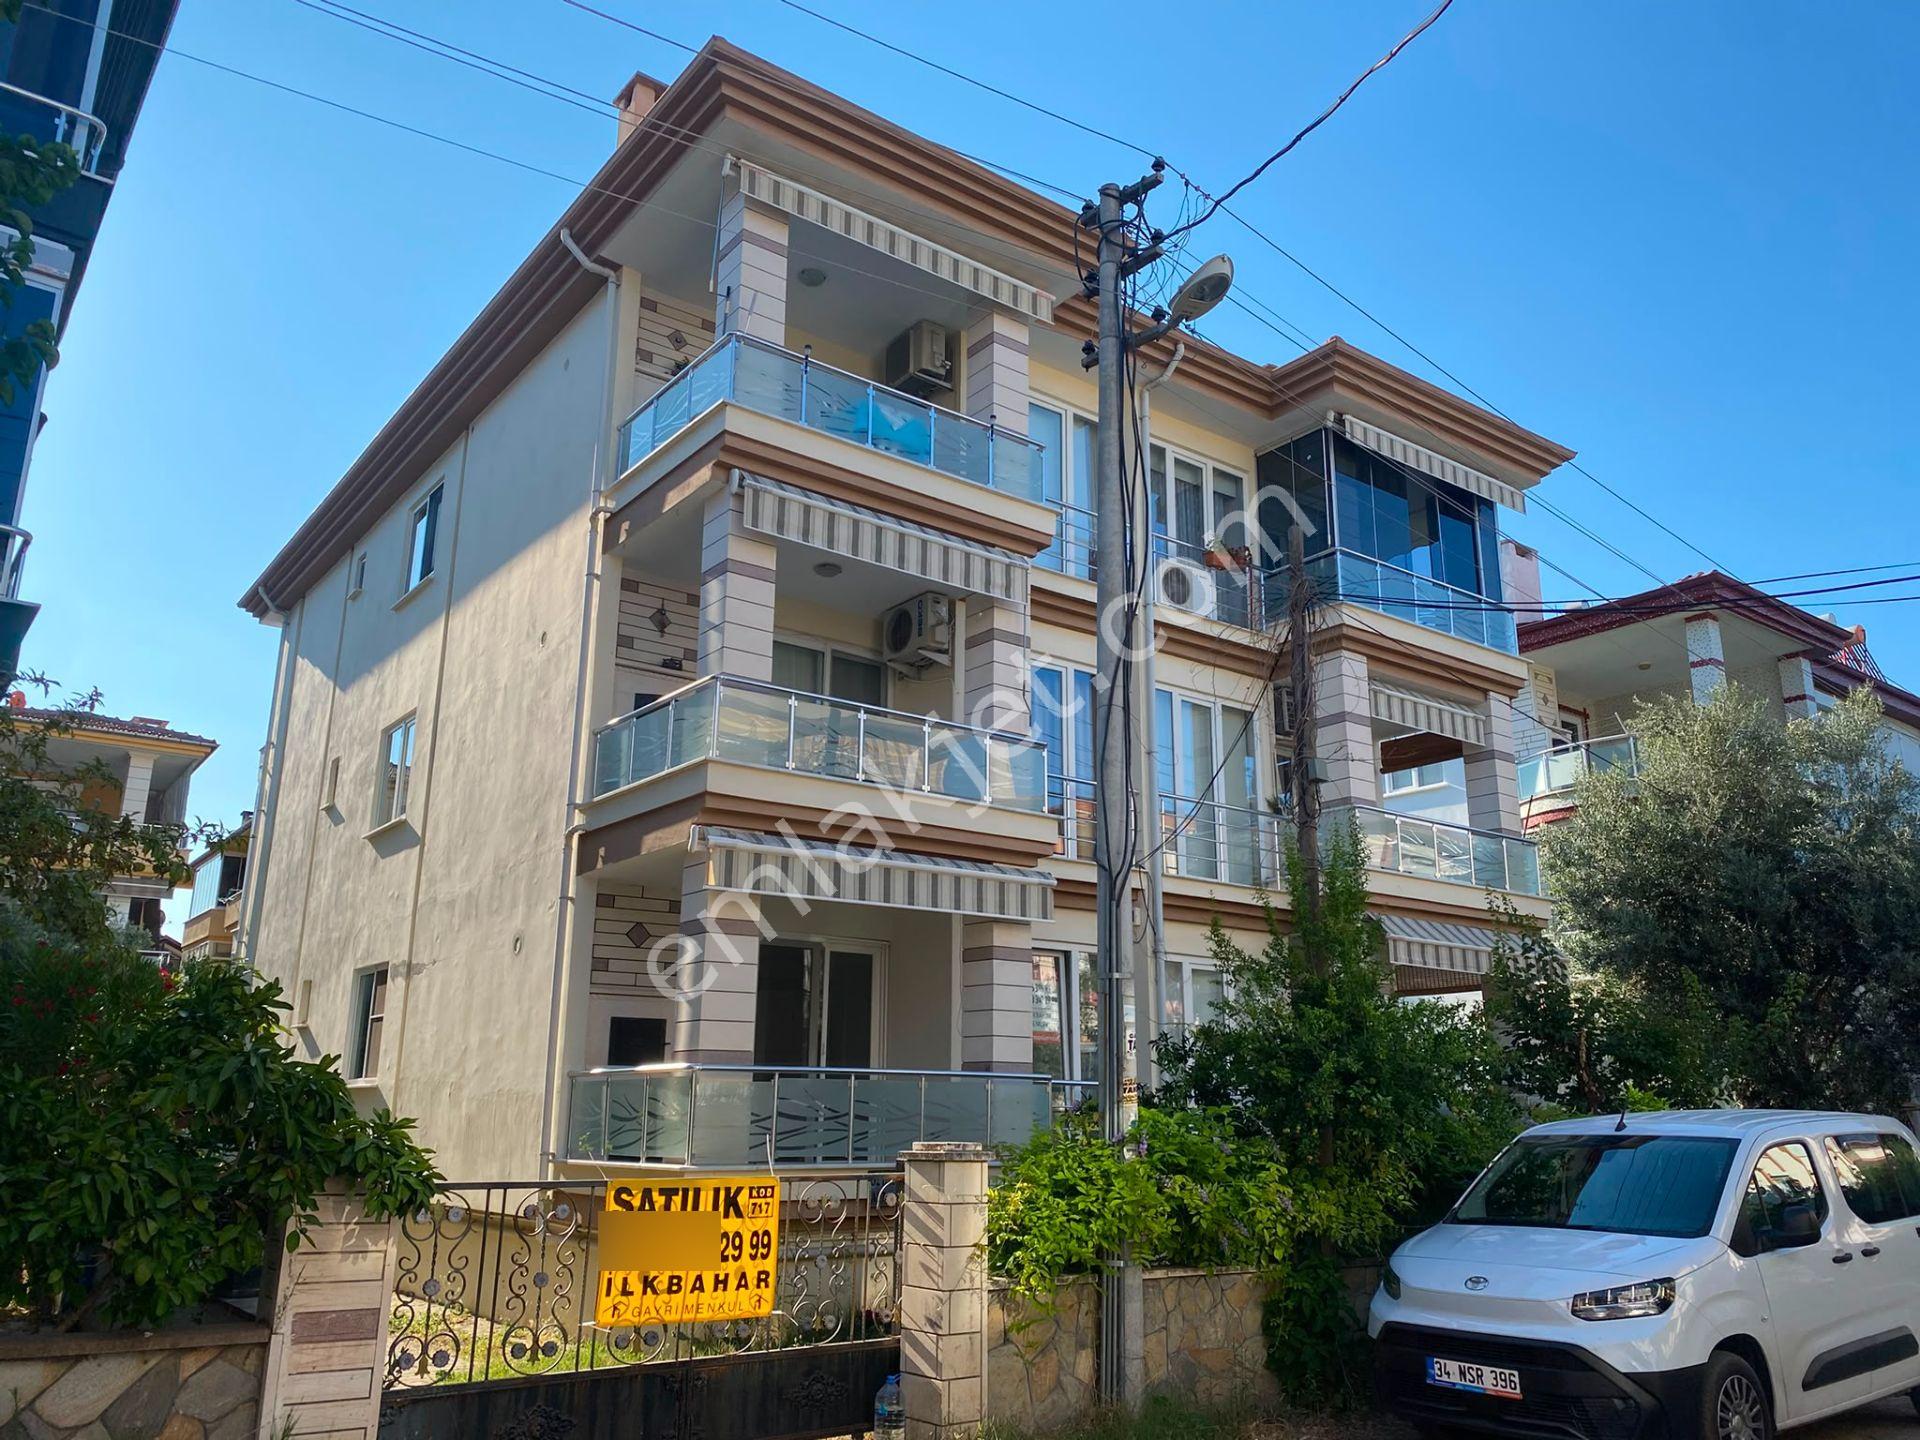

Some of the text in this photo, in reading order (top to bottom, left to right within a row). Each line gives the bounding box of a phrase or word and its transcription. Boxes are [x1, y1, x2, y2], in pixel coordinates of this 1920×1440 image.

[752, 1187, 773, 1198] KOD
[751, 1202, 771, 1215] 717
[749, 1229, 772, 1261] 99
[605, 1270, 770, 1297] İLKBAHAR
[1434, 1360, 1518, 1391] 34 NSR 396
